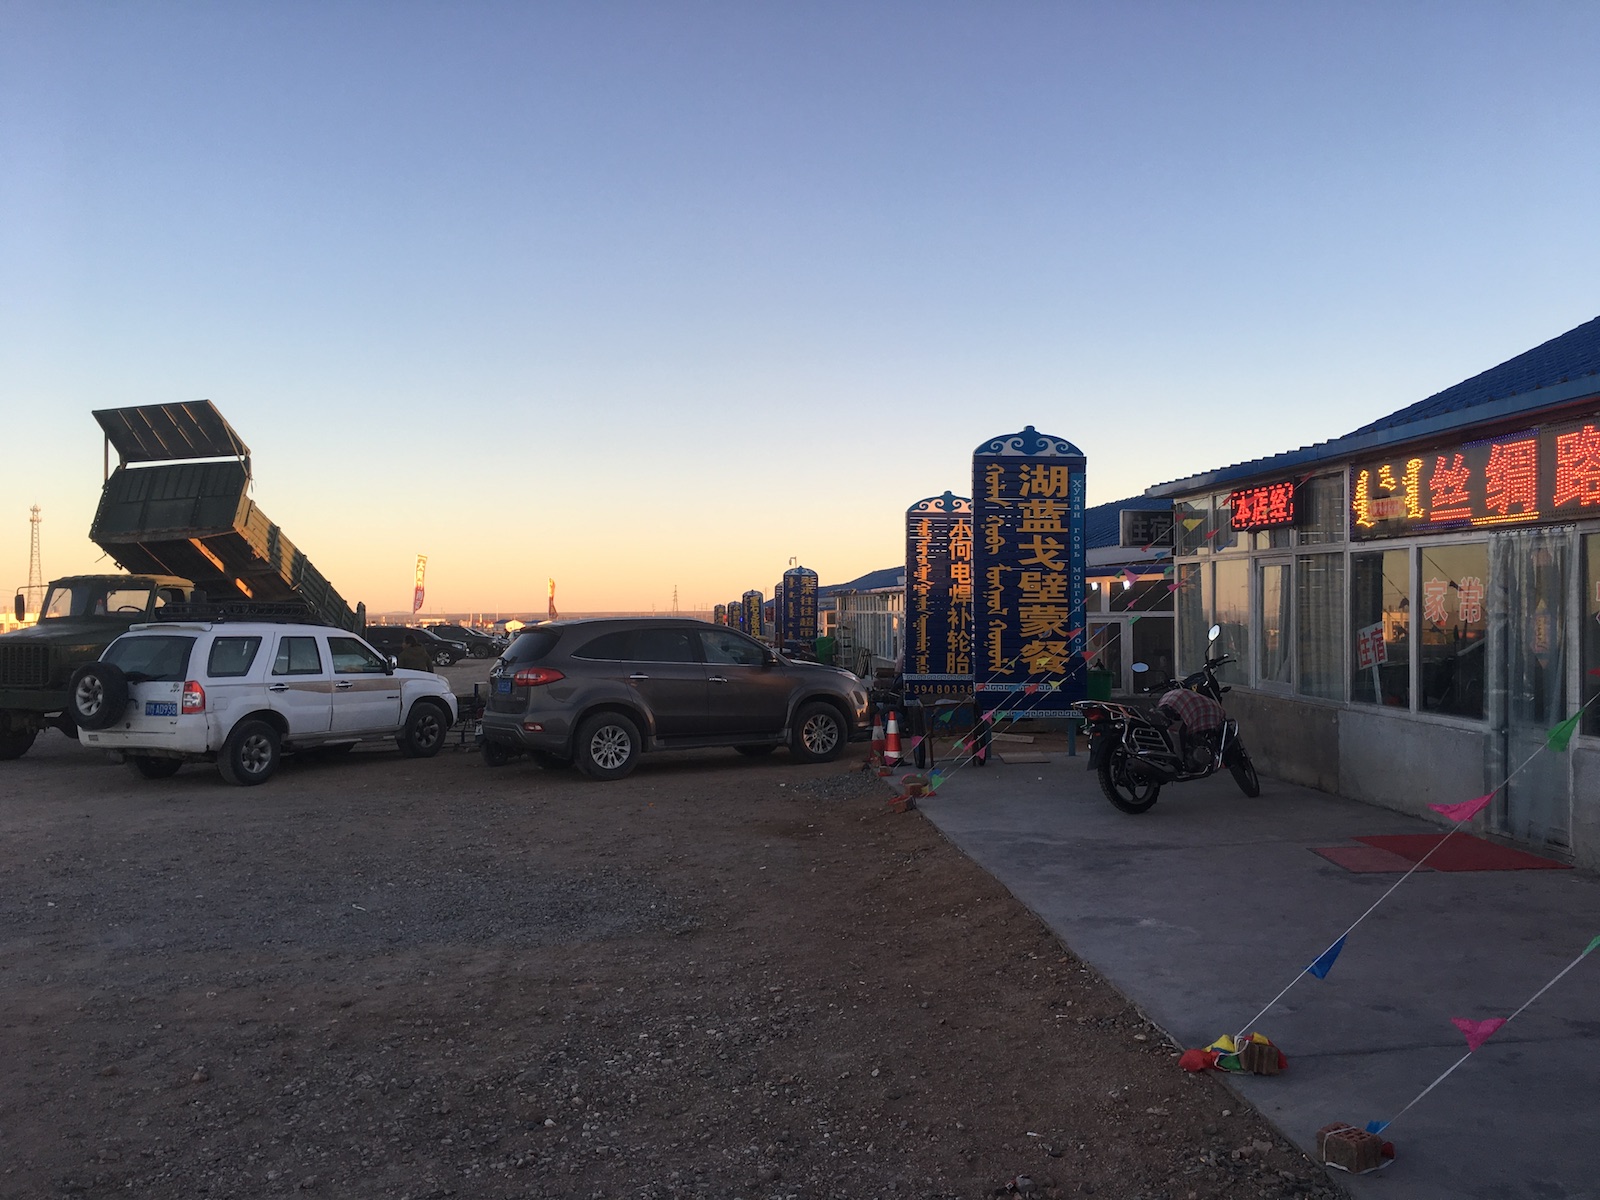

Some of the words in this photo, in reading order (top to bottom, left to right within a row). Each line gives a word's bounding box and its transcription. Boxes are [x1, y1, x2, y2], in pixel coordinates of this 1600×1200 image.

[1073, 480, 1082, 518] Хулан
[1016, 463, 1070, 675] 湖蓝戈壁蒙餐
[1423, 576, 1484, 623] 家常
[1074, 622, 1082, 651] хол
[1357, 627, 1386, 667] 住宿
